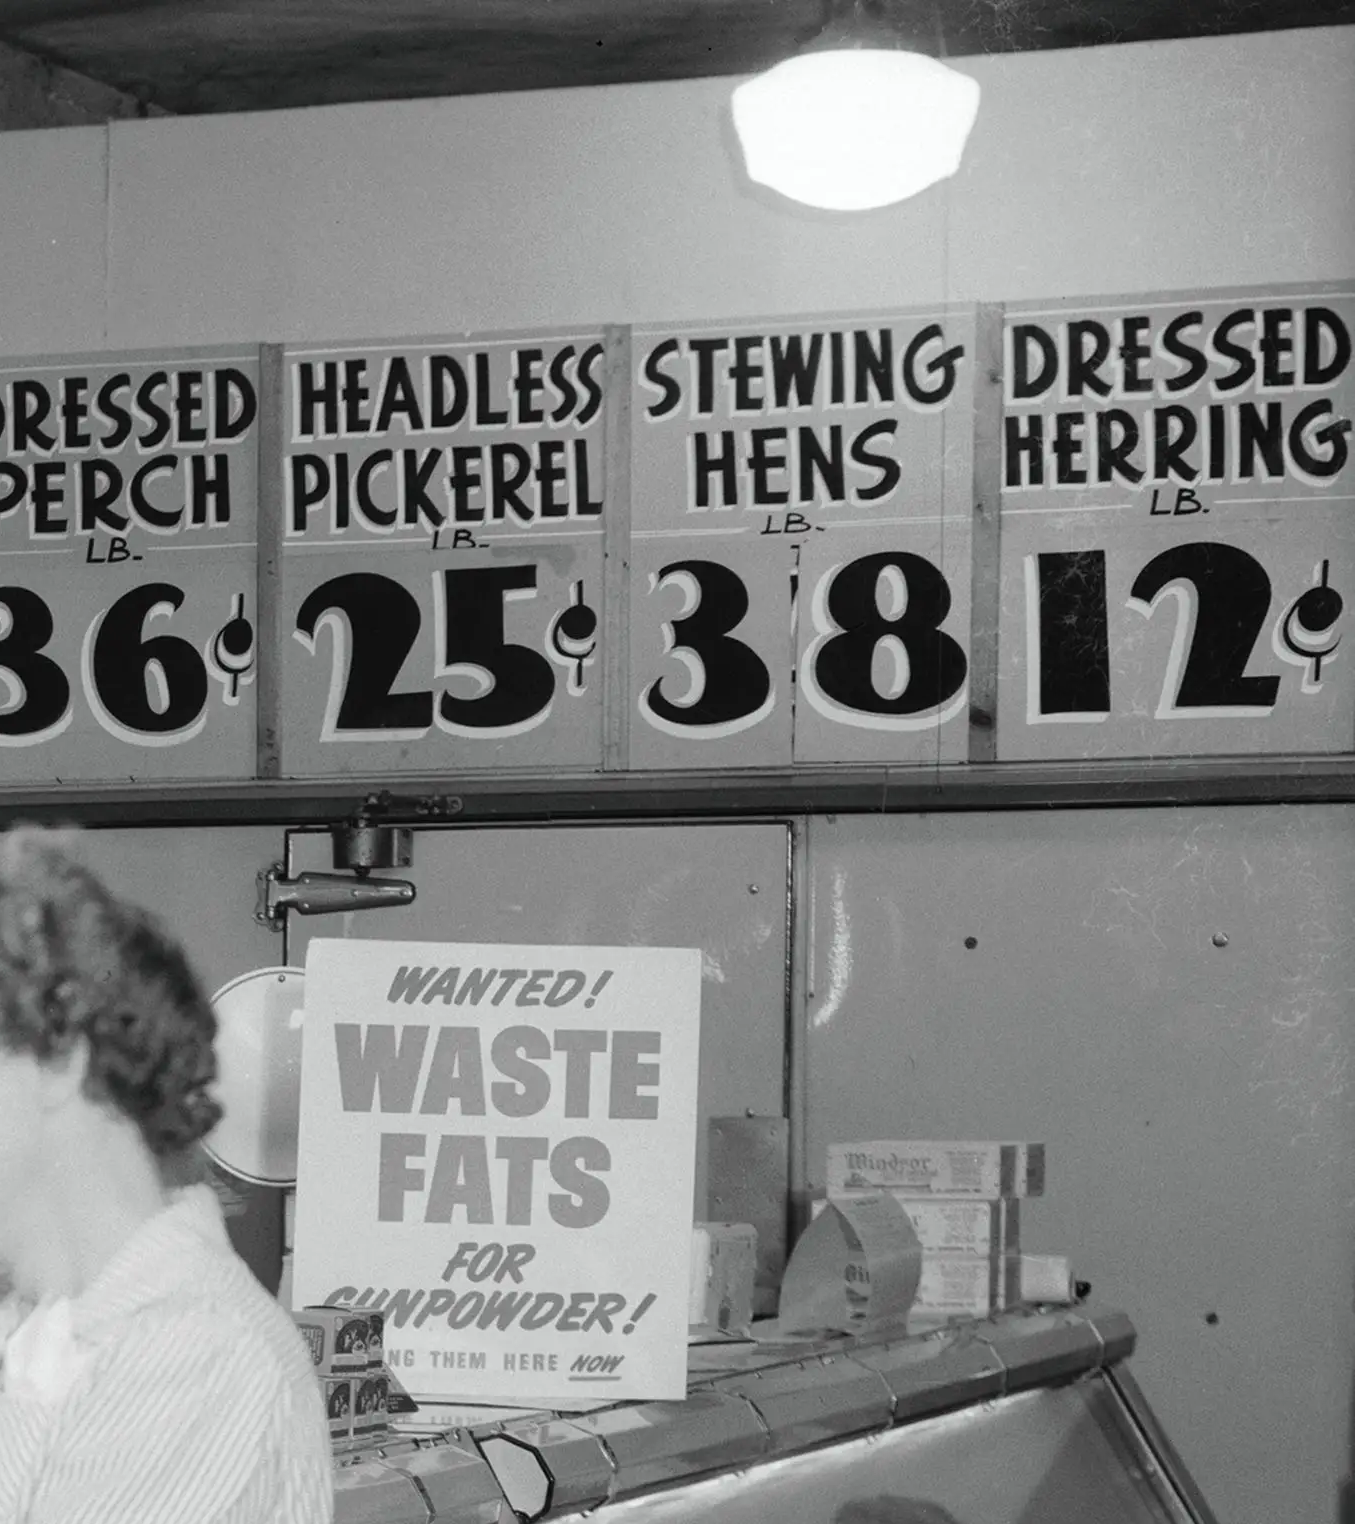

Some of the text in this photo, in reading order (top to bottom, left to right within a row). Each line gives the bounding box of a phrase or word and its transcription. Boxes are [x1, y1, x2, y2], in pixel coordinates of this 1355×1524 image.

[300, 342, 604, 442] HEADLESS
[645, 323, 964, 416] STEWING
[1009, 307, 1353, 399] DRESSED
[291, 439, 604, 534] PICKEREL
[696, 419, 904, 509] HENS
[1006, 399, 1353, 488] HERRING
[432, 525, 490, 550] LB.
[762, 513, 824, 536] LB.
[1151, 487, 1209, 516] LB.
[87, 536, 142, 565] LB.
[645, 550, 966, 722] 38
[386, 966, 613, 1008] WANTED!
[334, 1025, 662, 1120] WASTE
[377, 1136, 612, 1228] FATS
[442, 1242, 536, 1284] FOR
[430, 1351, 487, 1370] THEM
[503, 1353, 559, 1372] HERE
[569, 1354, 625, 1374] NOW
